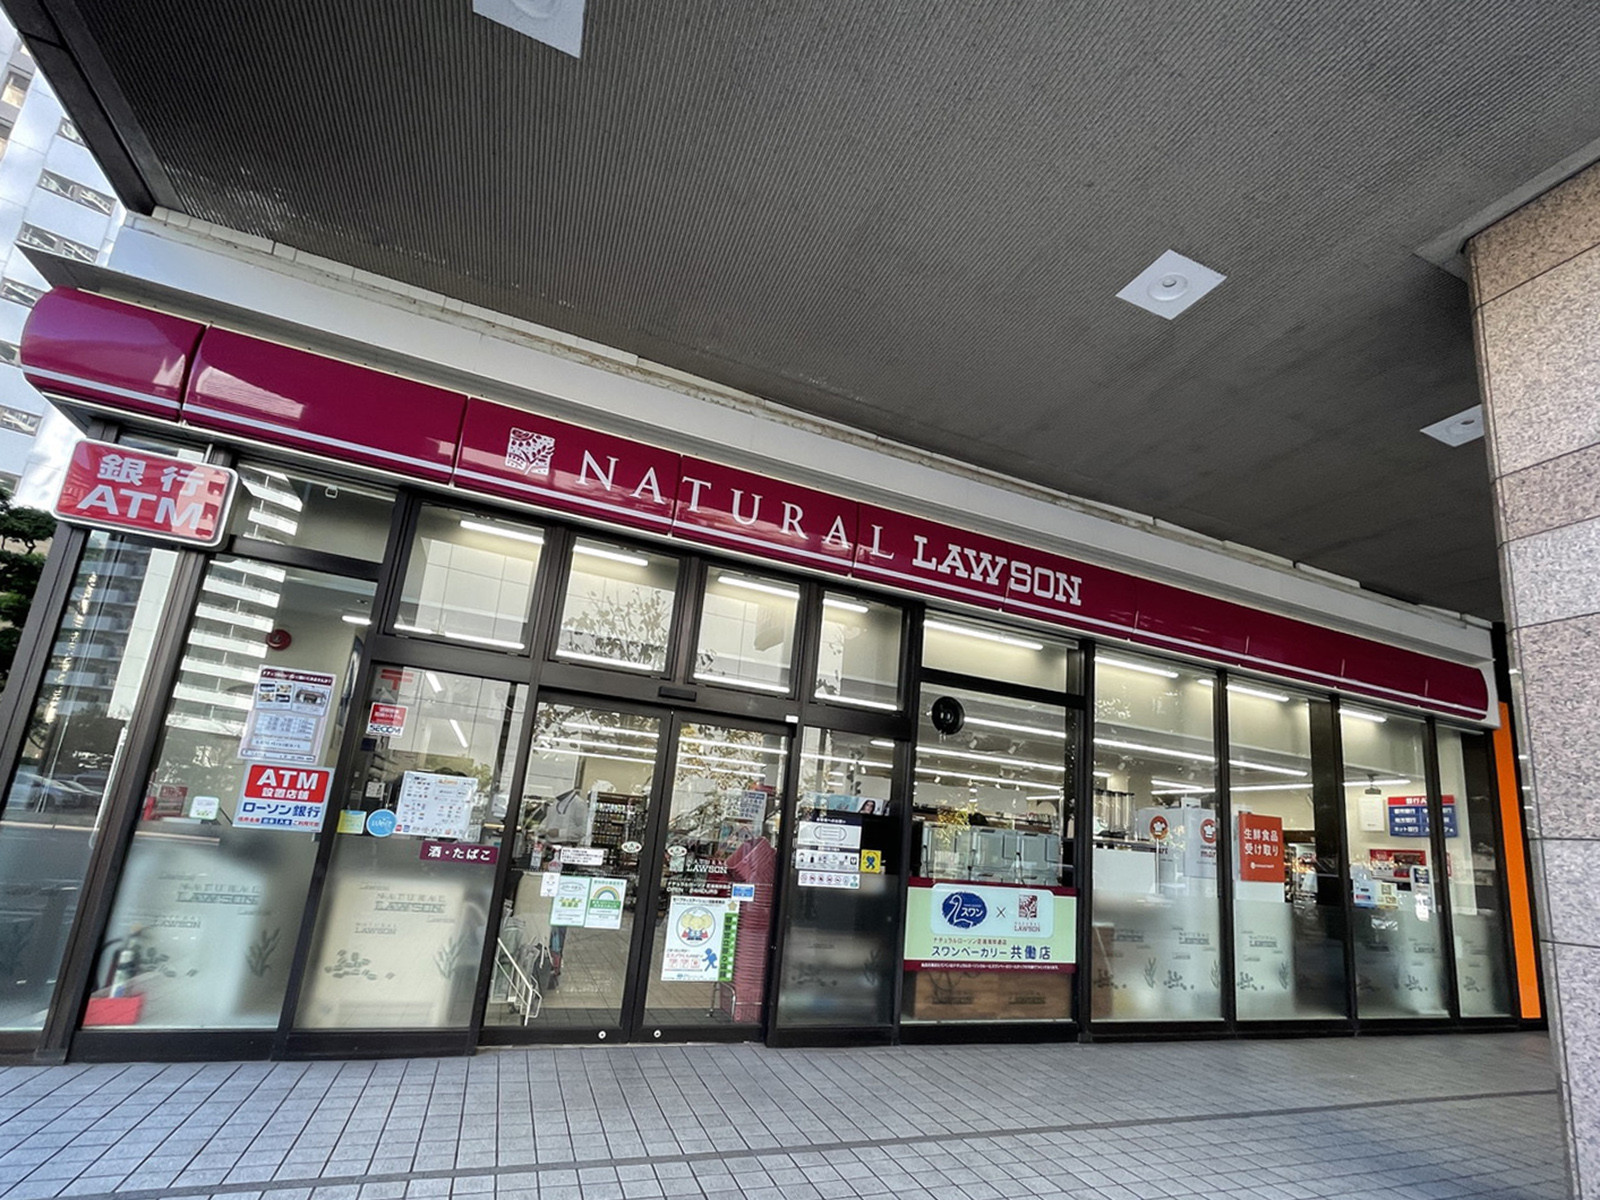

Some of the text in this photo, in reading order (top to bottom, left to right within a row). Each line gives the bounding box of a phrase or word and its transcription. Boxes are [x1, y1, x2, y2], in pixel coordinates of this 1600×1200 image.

[97, 454, 204, 496] 銀行
[77, 486, 203, 531] ATM
[576, 449, 1083, 608] NATURAL LAWSON
[256, 768, 319, 790] ATM
[242, 802, 320, 818] ローソン銀行
[1244, 828, 1279, 842] 生鮮食品
[428, 845, 491, 861] 酒・たばこ
[1244, 842, 1279, 857] 受け取り
[686, 864, 728, 874] LAWSON
[960, 907, 984, 917] スワン
[931, 945, 1051, 960] スワンベーカリー共働店
